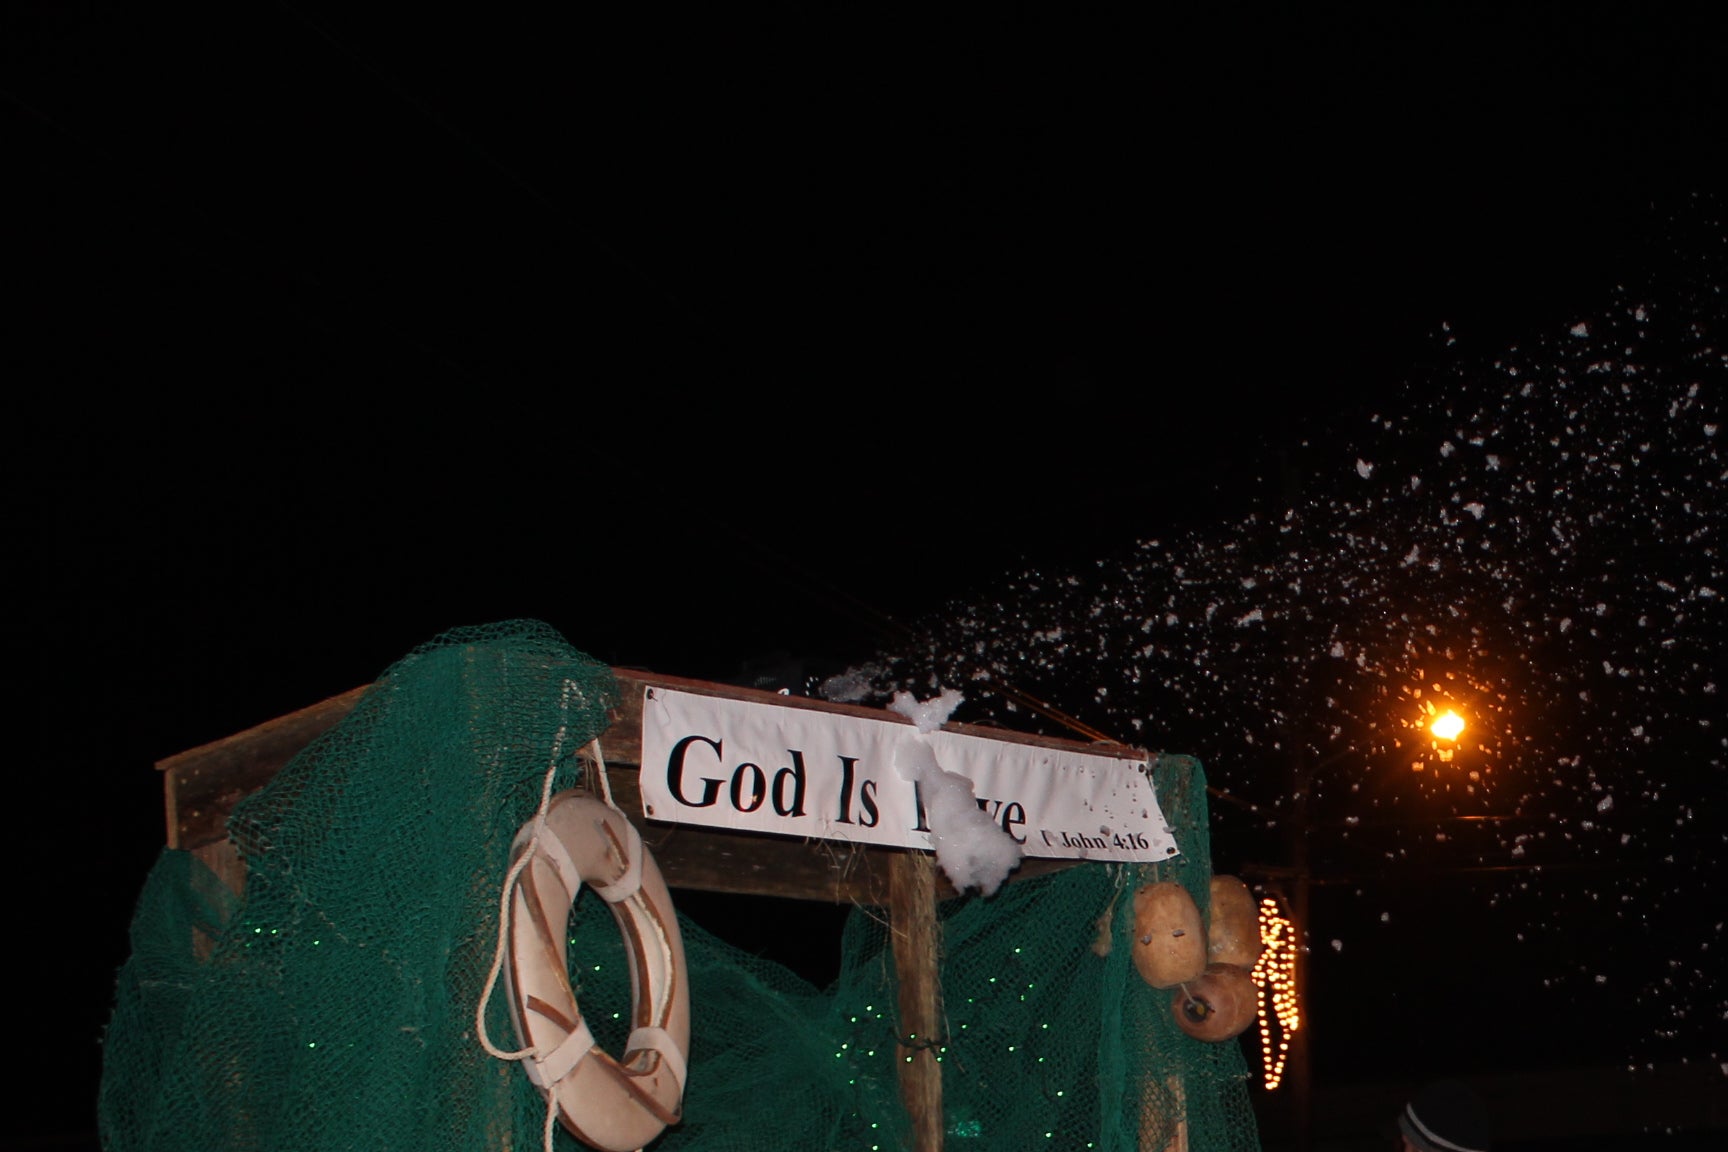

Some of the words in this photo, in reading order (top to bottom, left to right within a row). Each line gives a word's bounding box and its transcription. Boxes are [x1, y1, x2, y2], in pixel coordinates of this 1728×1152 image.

[666, 734, 807, 818] God
[834, 755, 880, 828] Is
[1060, 831, 1108, 850] John
[1112, 830, 1151, 851] 4:16
